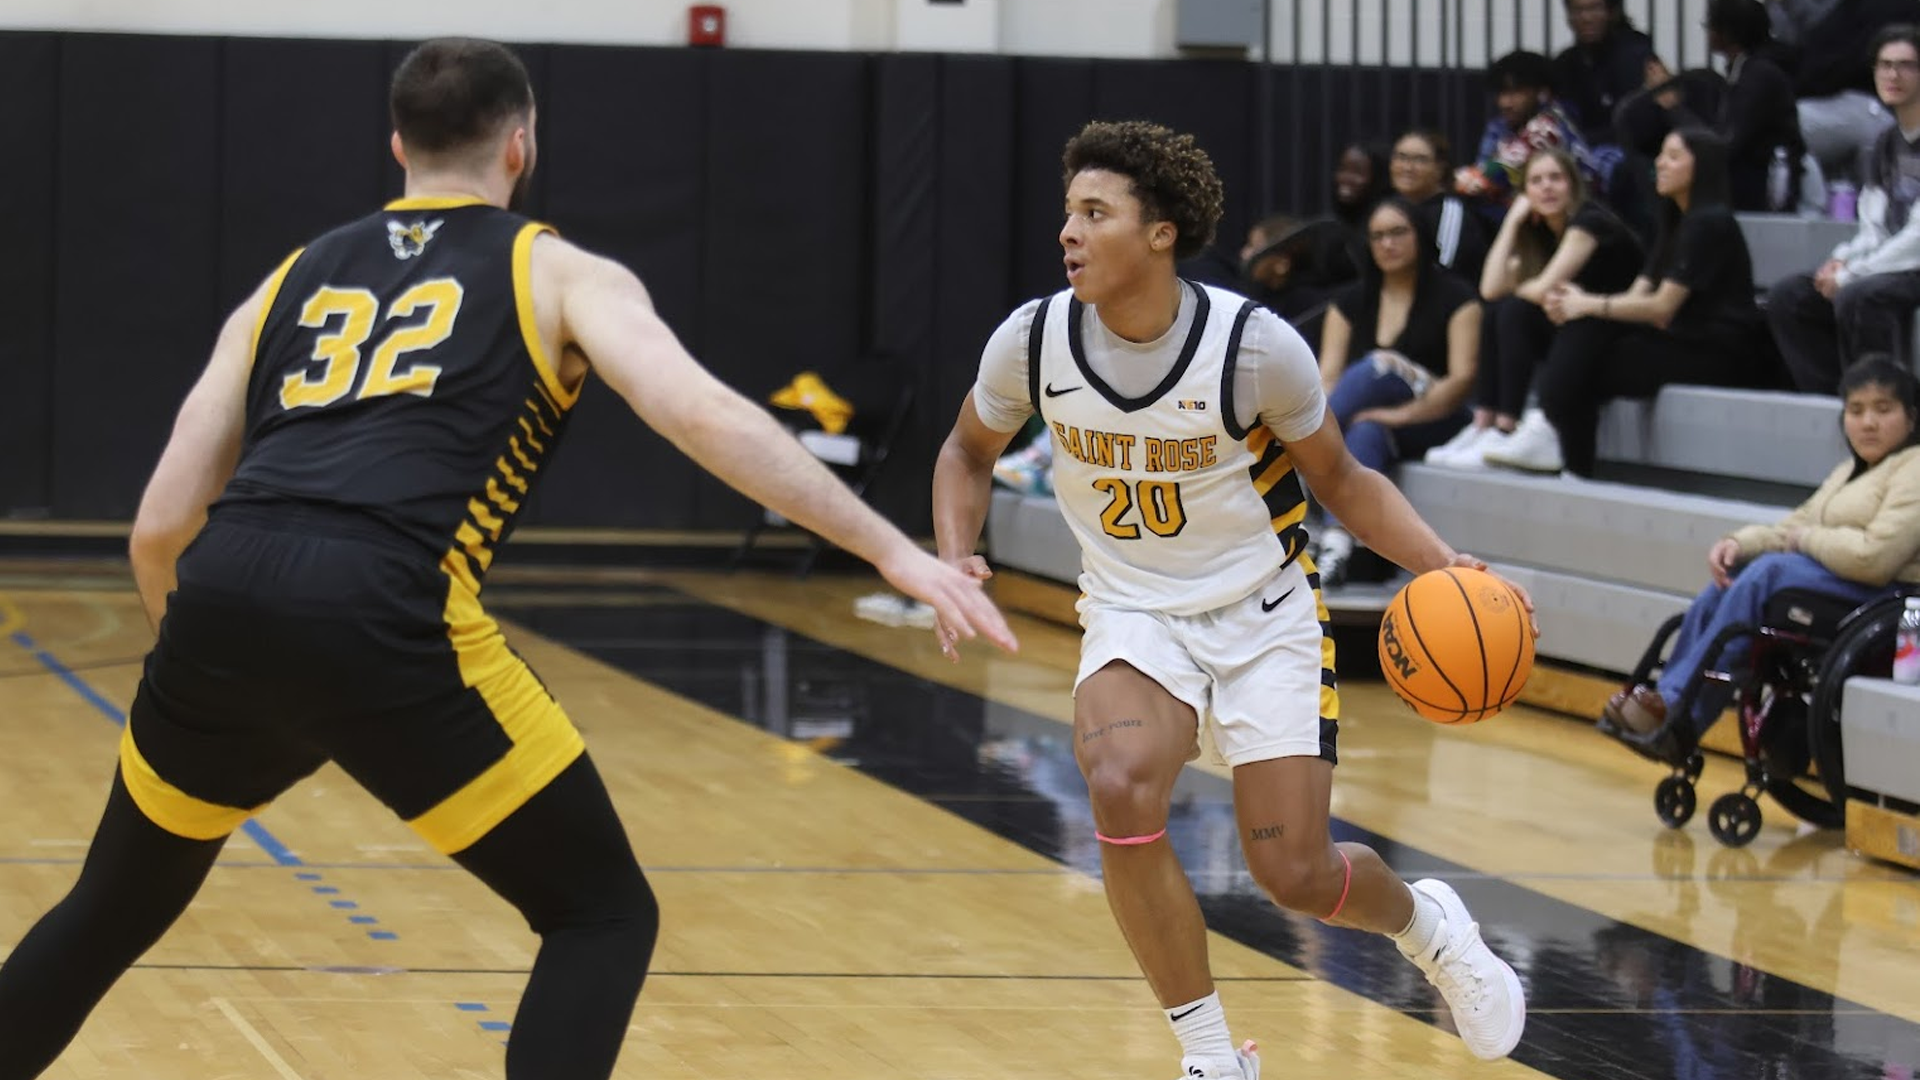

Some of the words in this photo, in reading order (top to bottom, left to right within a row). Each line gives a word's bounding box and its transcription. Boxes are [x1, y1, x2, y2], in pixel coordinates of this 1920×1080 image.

[279, 276, 464, 411] 32
[1178, 400, 1206, 410] NE10
[1052, 420, 1135, 471] SAINT
[1145, 434, 1217, 472] ROSE
[1092, 478, 1187, 540] 20
[1382, 610, 1418, 681] NCAA
[1251, 823, 1284, 841] MMV
